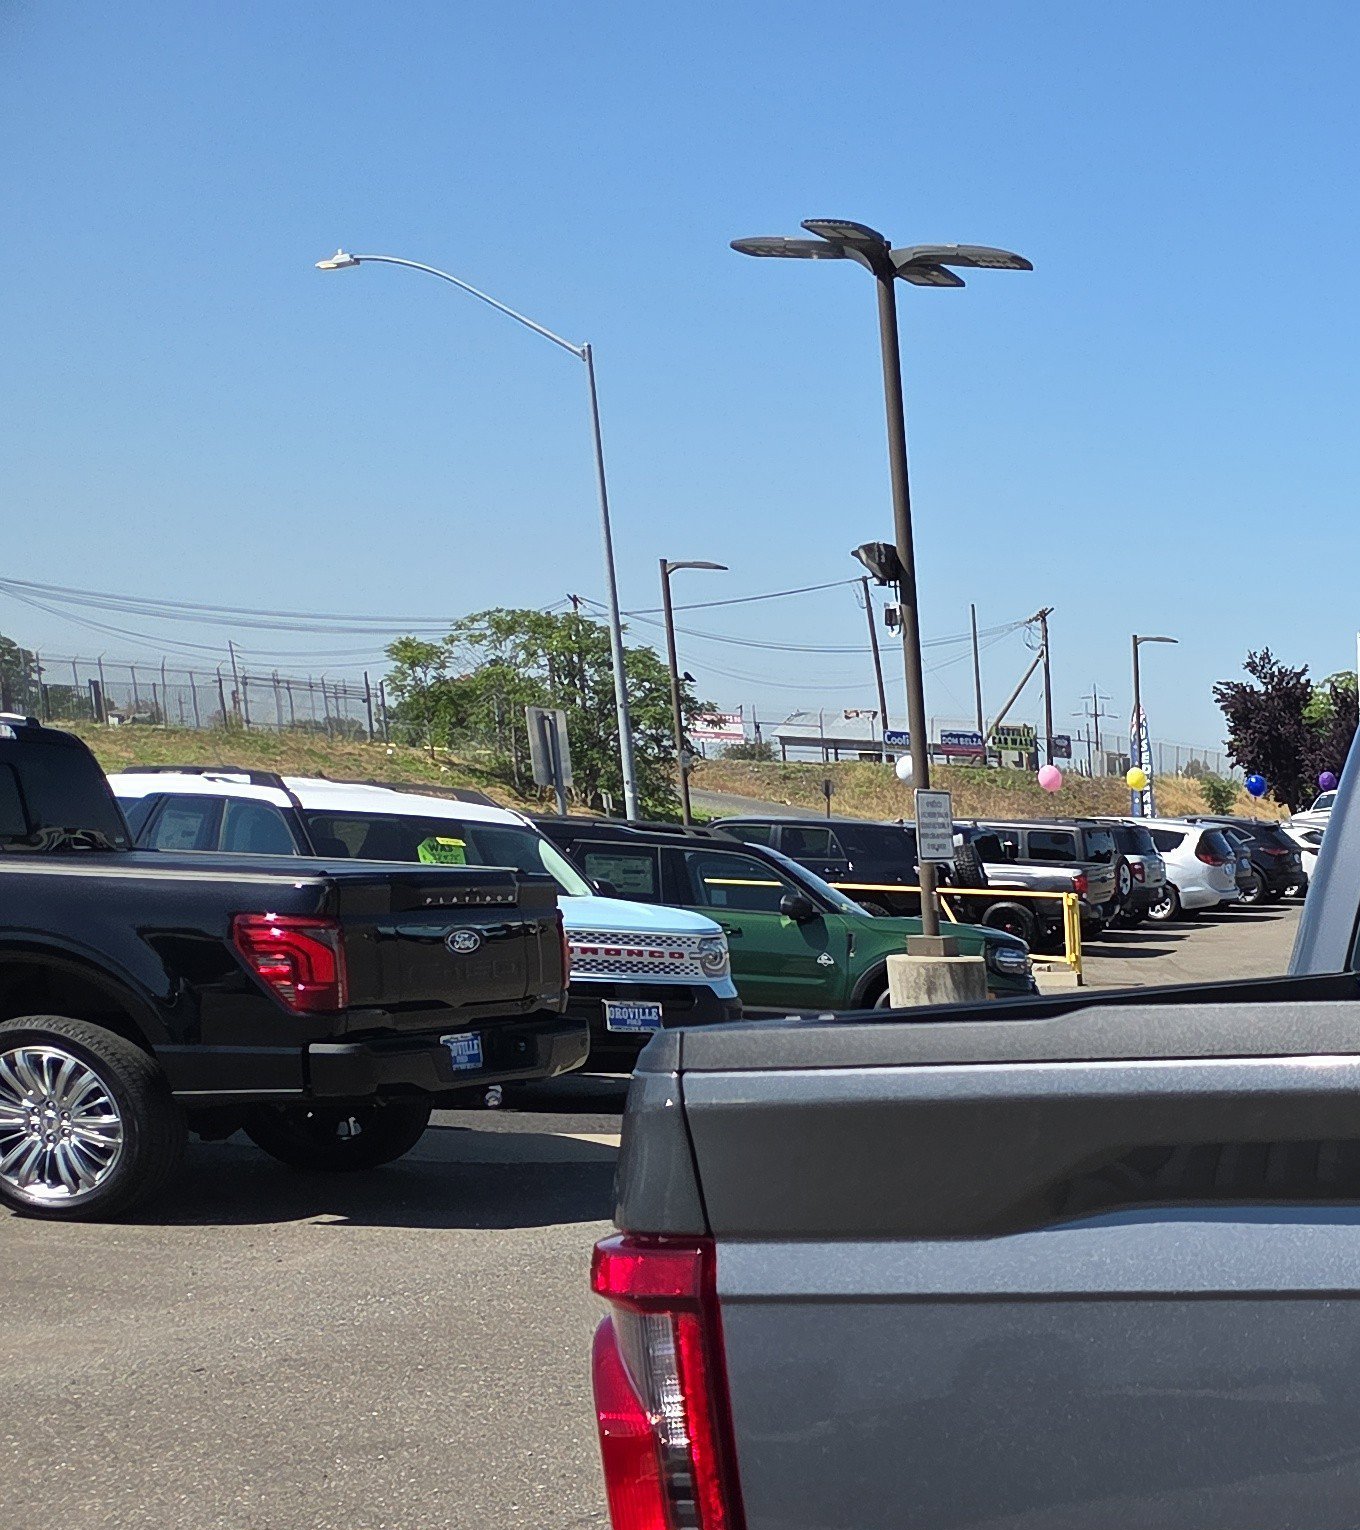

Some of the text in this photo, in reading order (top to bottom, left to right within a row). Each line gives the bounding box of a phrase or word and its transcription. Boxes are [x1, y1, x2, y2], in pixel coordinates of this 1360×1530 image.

[884, 731, 910, 746] Cooli
[569, 947, 685, 959] RONCO
[609, 1007, 659, 1021] OROVILLE
